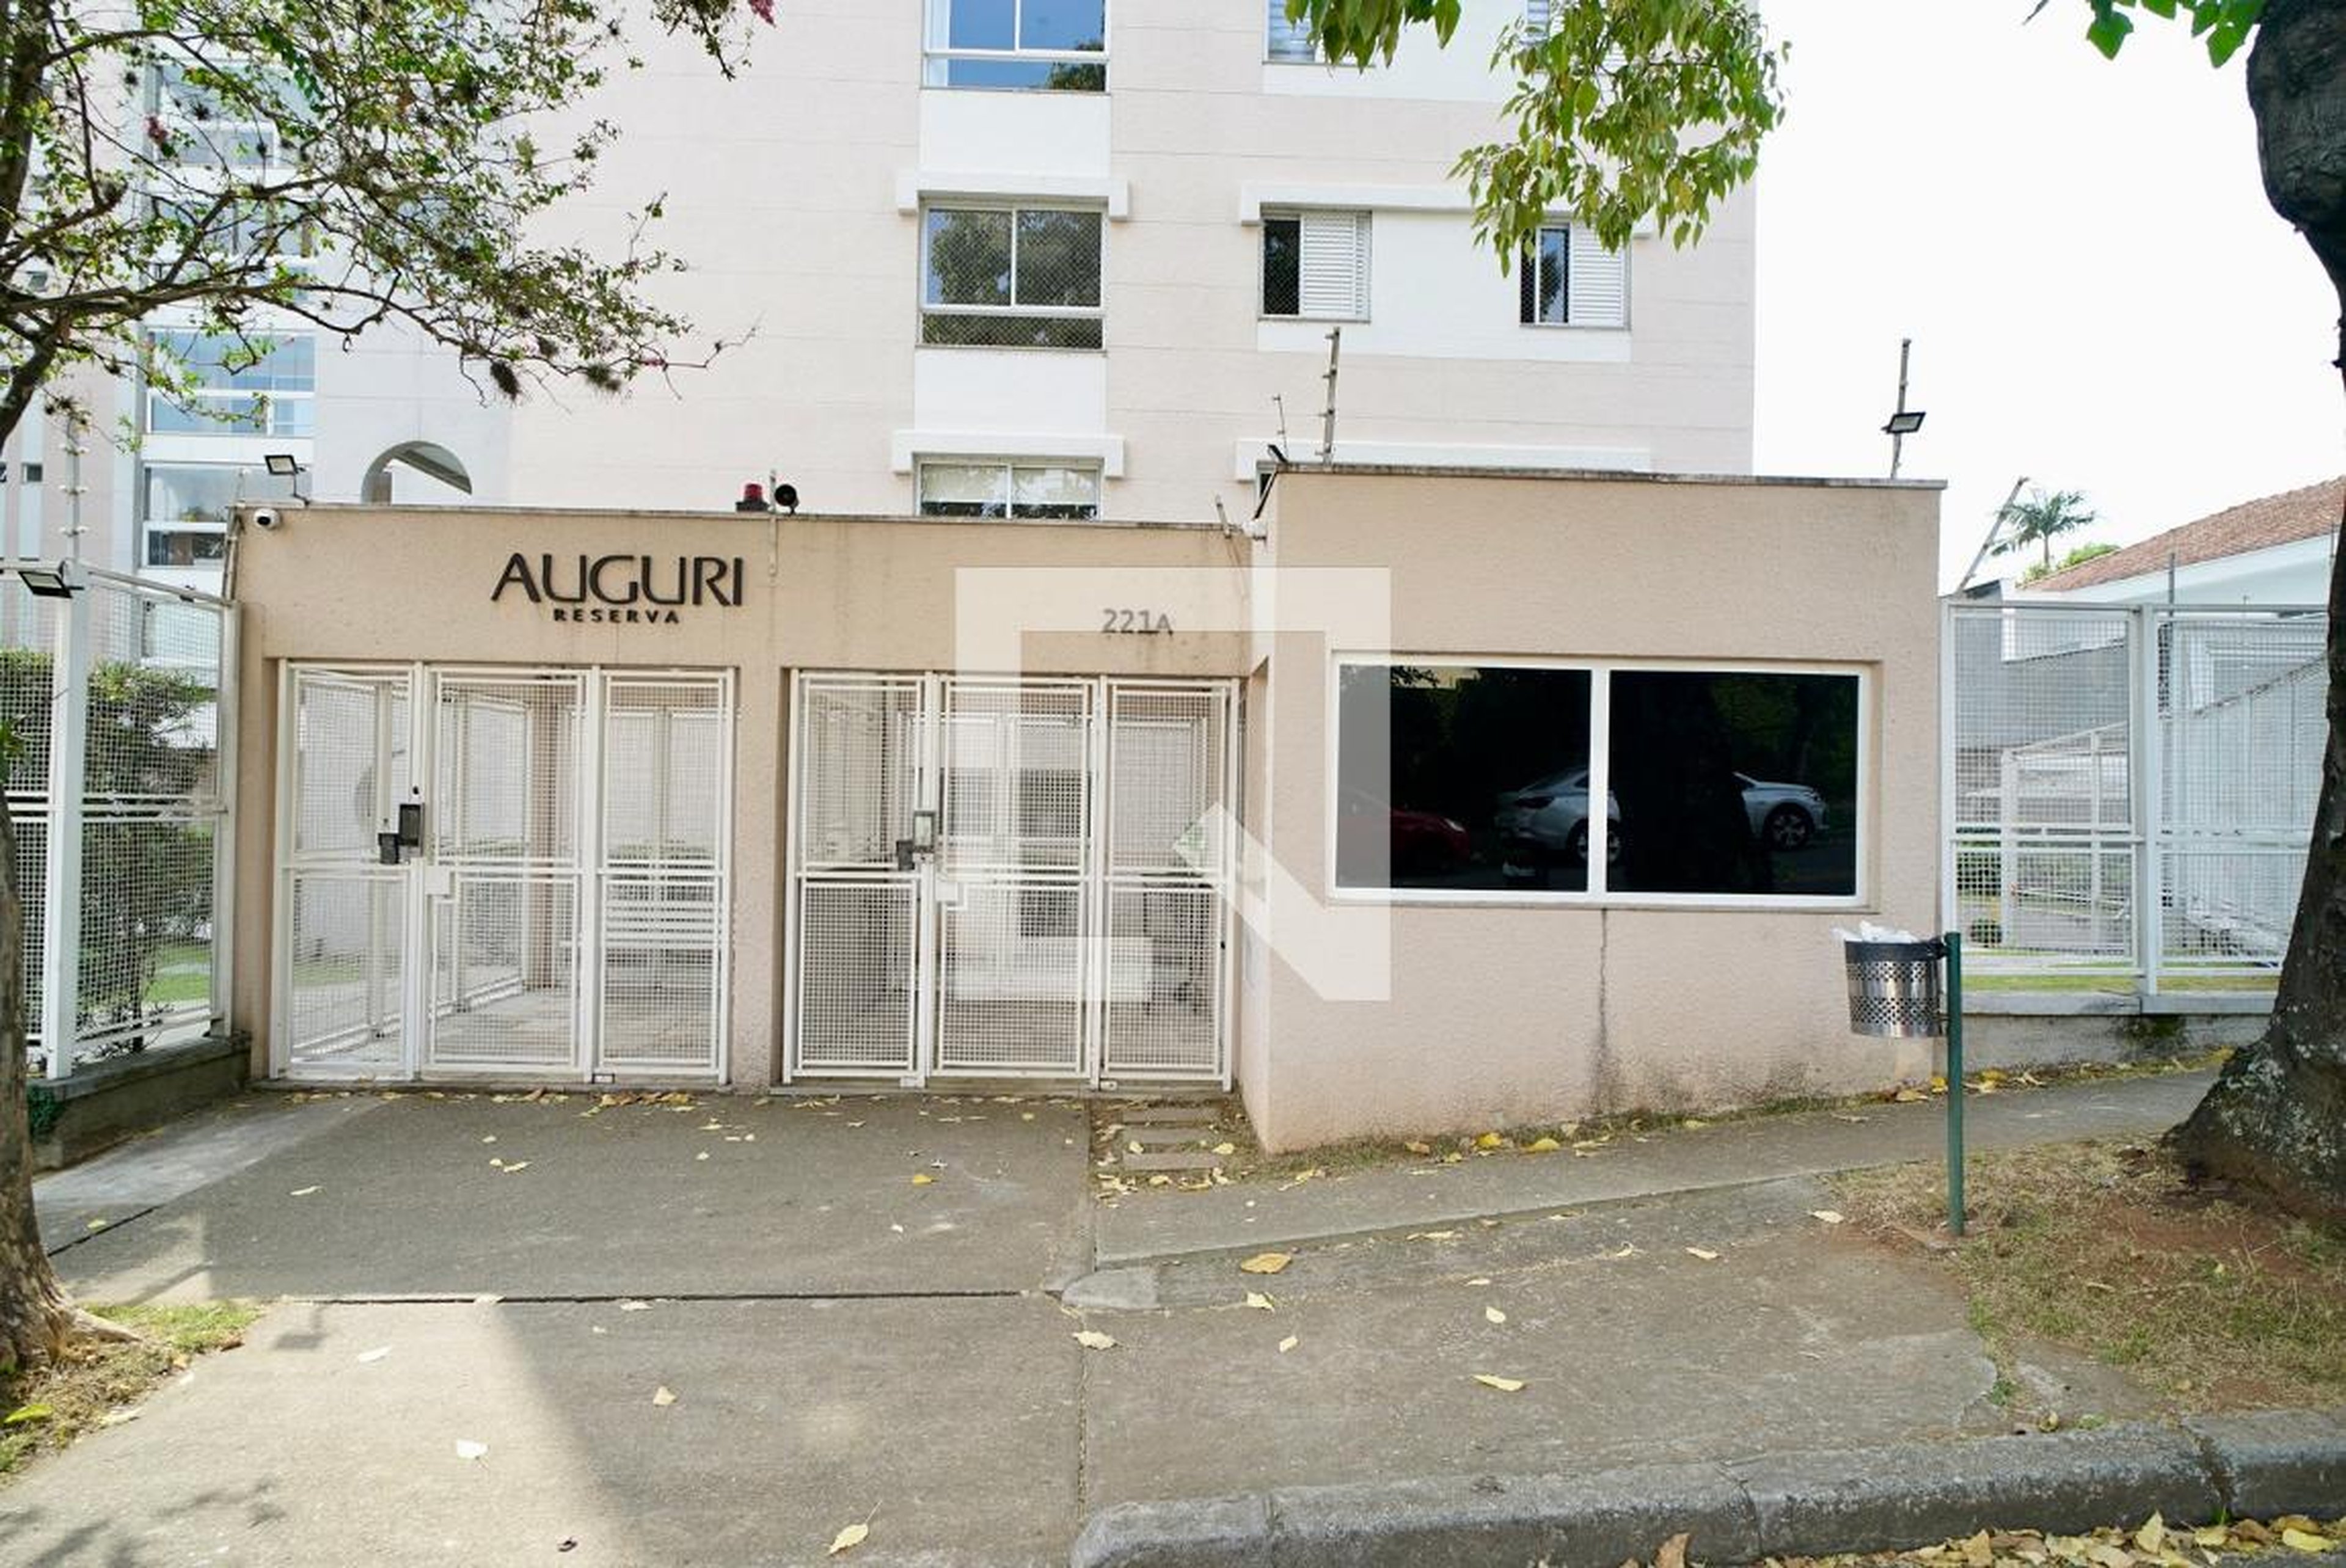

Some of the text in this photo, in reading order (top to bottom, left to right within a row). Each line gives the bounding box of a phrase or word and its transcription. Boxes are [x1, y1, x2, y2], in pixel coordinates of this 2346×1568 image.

[491, 553, 743, 606] AUGURI
[554, 608, 680, 624] RESERVA
[1102, 609, 1174, 636] 221A
